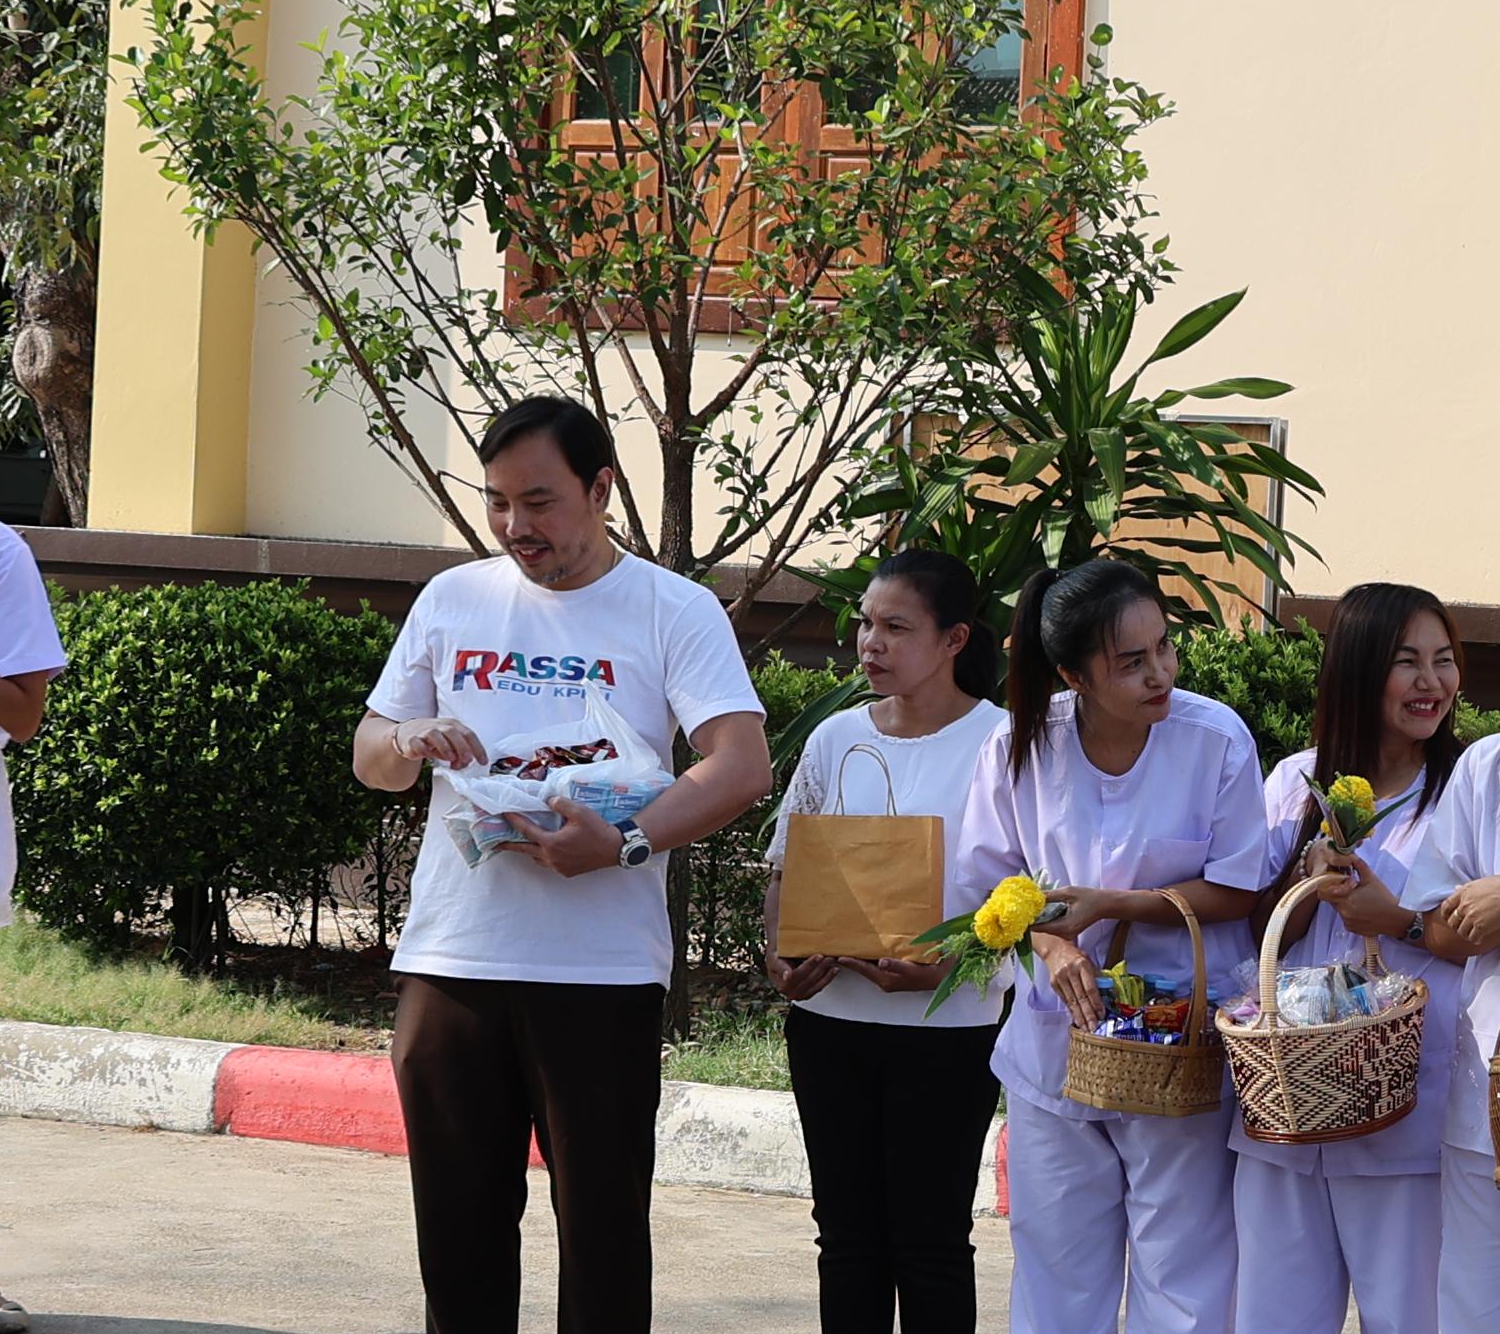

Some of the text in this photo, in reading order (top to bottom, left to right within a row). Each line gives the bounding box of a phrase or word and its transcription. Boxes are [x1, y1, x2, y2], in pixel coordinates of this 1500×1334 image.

[452, 650, 616, 692] RASSA
[497, 679, 611, 701] EDU KP
